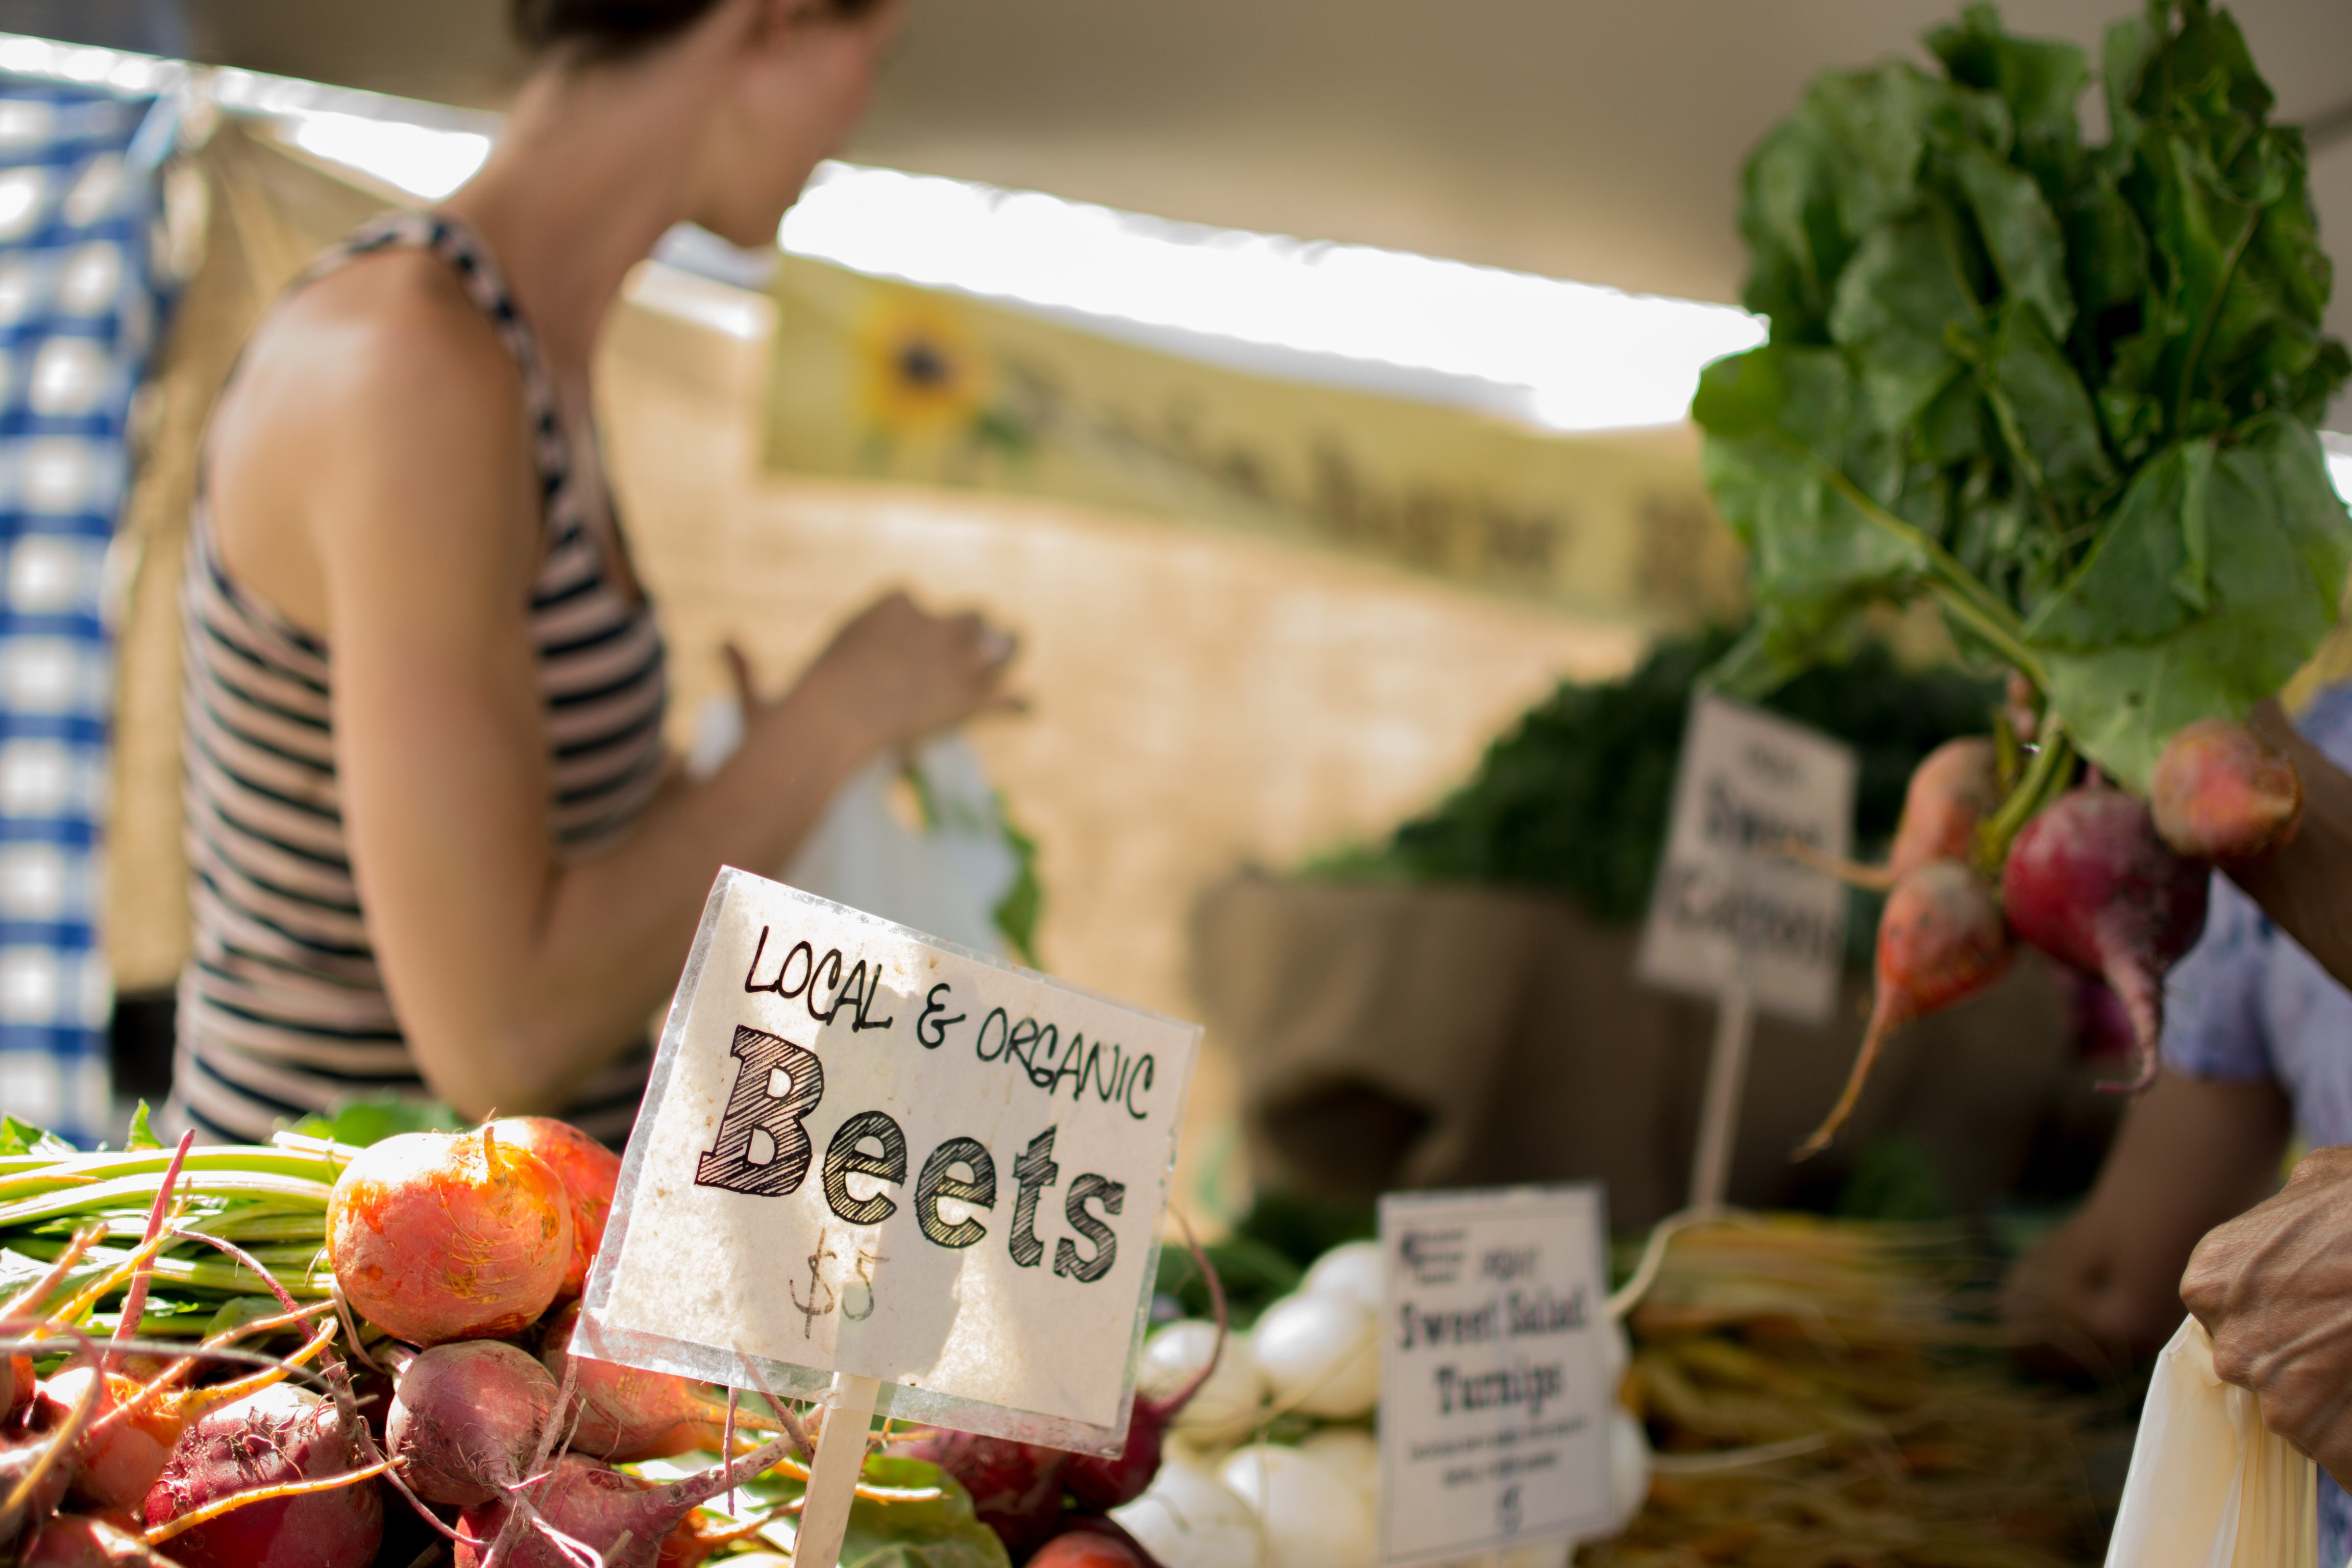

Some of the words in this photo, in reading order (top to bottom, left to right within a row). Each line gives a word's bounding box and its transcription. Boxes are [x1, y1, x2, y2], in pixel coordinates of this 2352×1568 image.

[744, 925, 894, 1033] LOCAL
[917, 983, 967, 1049] &
[976, 1007, 1155, 1120] ORGANIC
[694, 1023, 1127, 1283] Beets
[789, 1228, 890, 1339] $5
